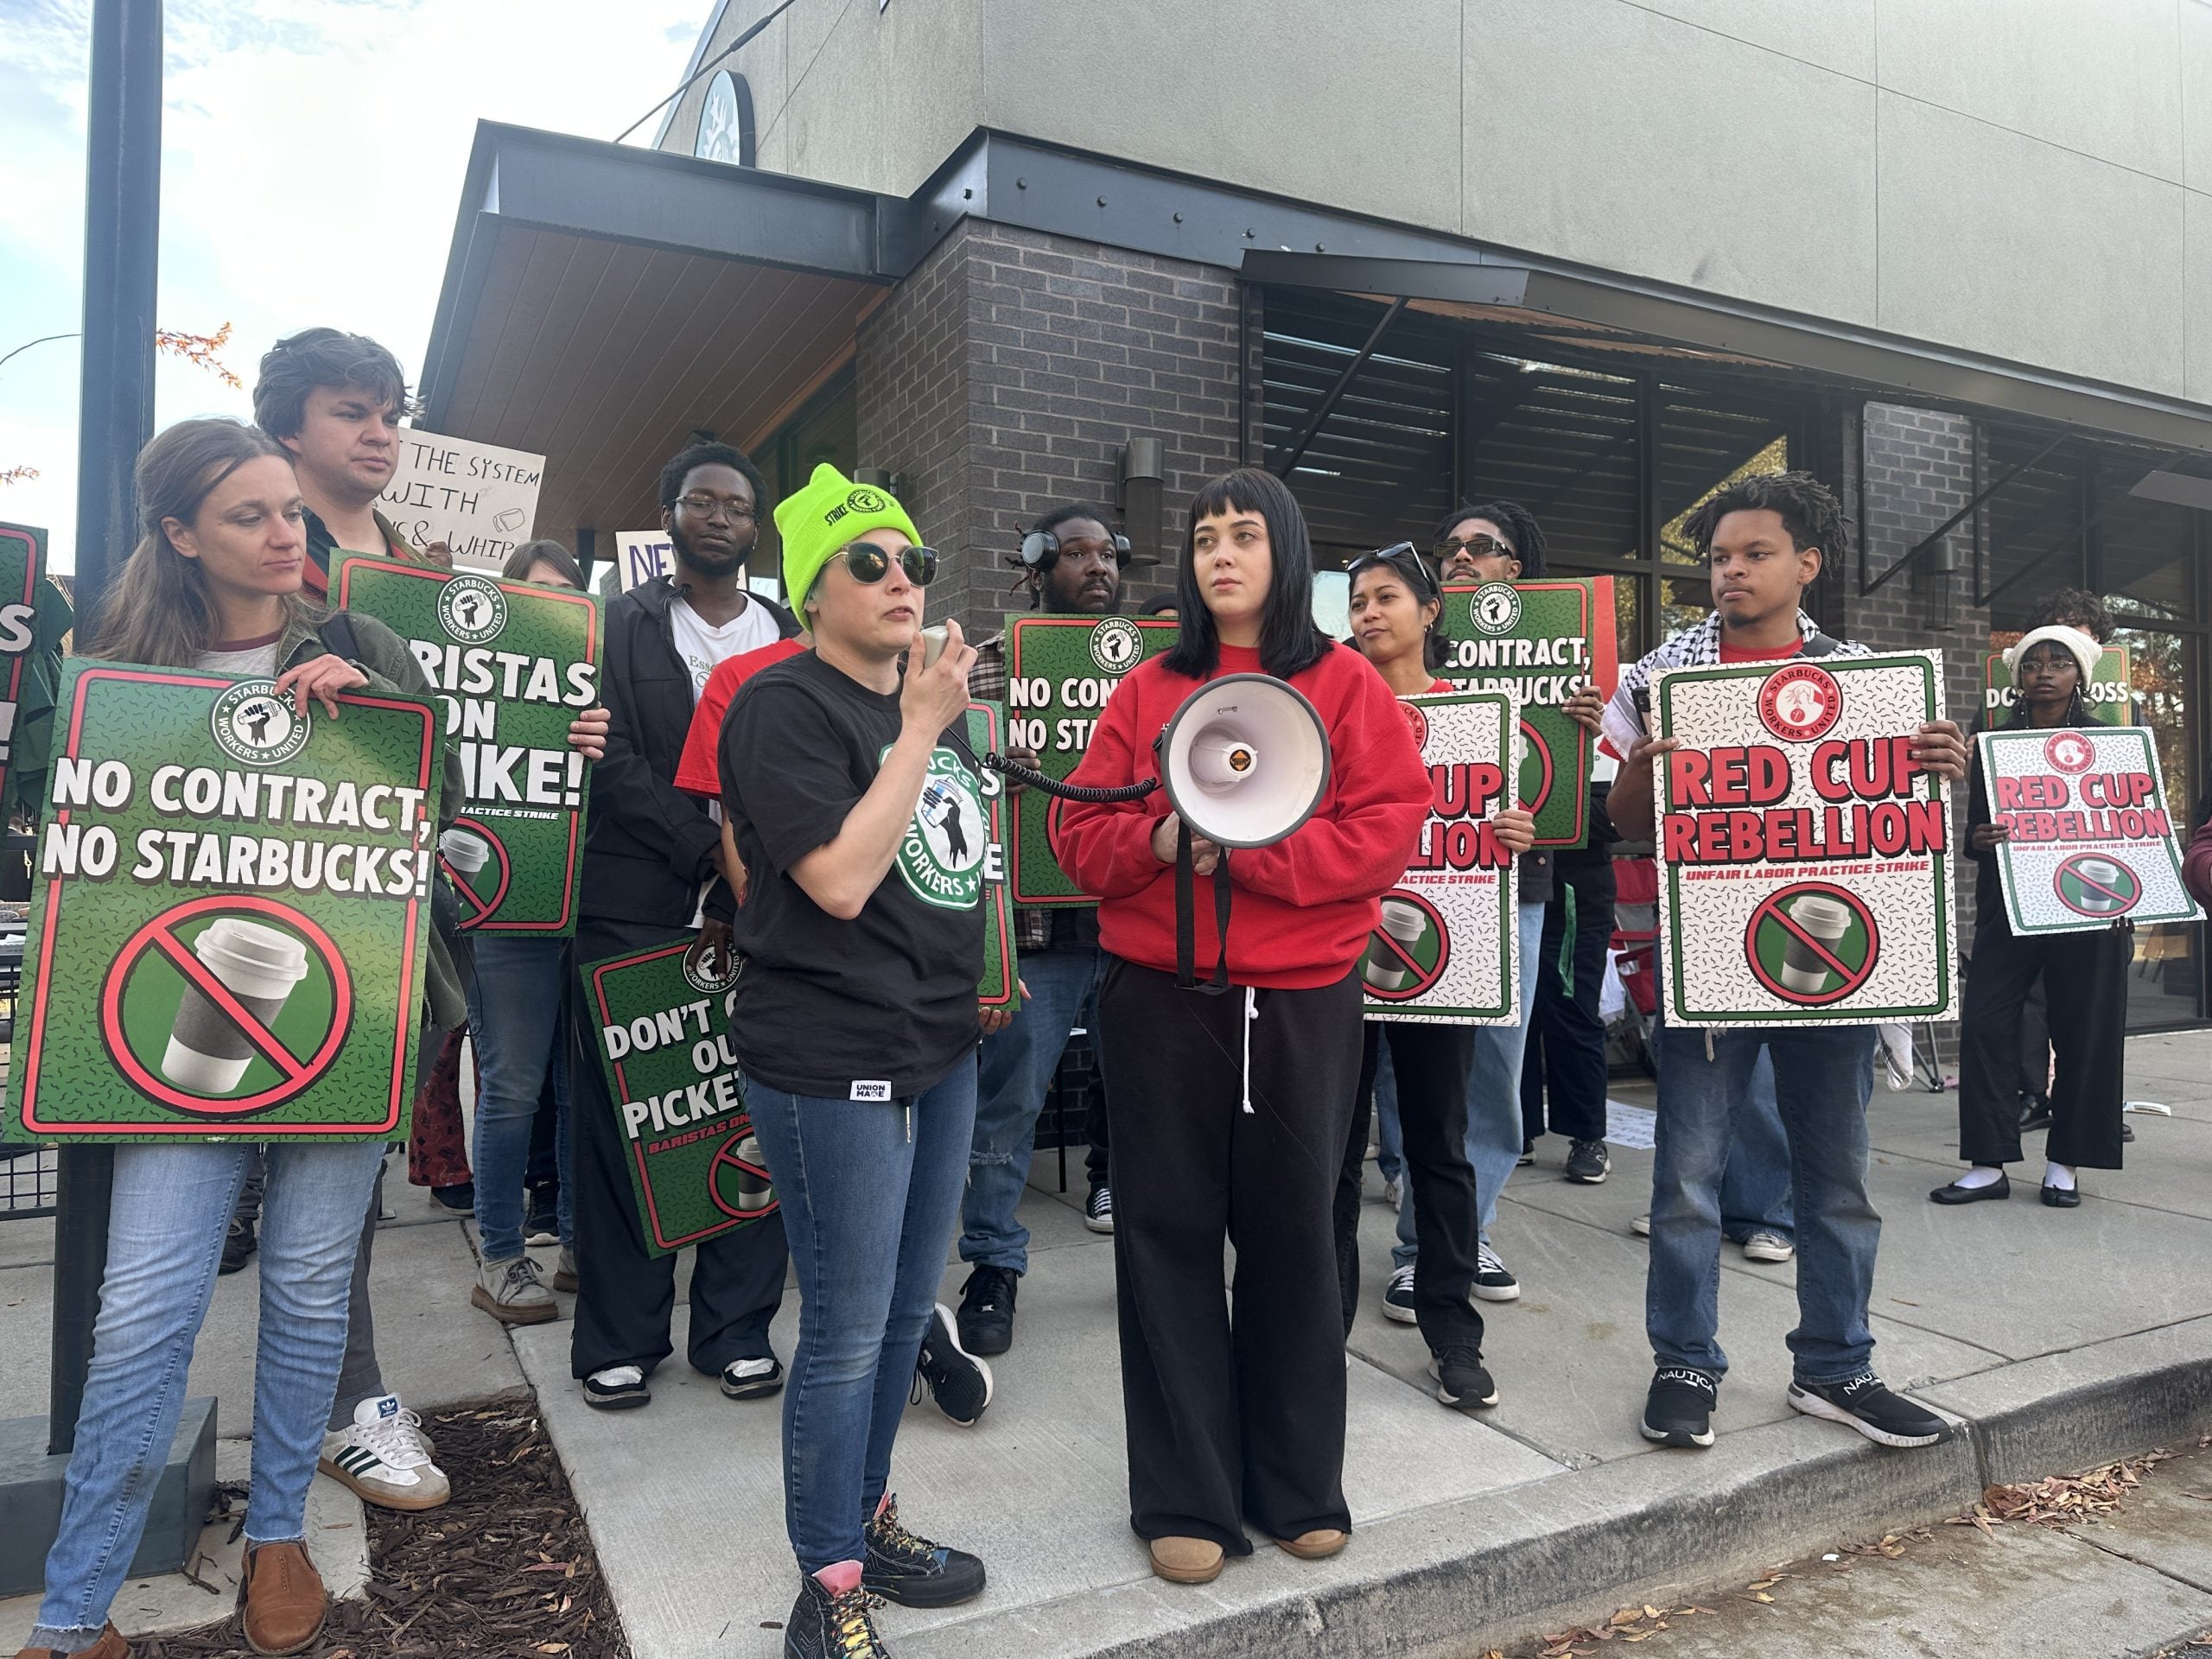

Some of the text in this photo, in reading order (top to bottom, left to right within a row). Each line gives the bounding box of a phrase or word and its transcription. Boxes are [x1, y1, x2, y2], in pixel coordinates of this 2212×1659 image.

[410, 442, 540, 486] THE SYSTEM
[380, 481, 479, 514] WITH
[824, 503, 849, 527] STRIKE
[449, 579, 499, 601] STARBUCKS
[1477, 585, 1515, 600] STARBUCKS
[442, 605, 470, 639] WORKERS
[480, 613, 502, 638] UNITED
[1098, 620, 1136, 636] STARBUCKS
[1473, 608, 1496, 632] WORKERS
[1502, 607, 1518, 628] UNITED
[410, 639, 596, 706] RISTAS
[1093, 645, 1116, 670] WORKERS
[1123, 645, 1140, 667] UNITED
[1009, 677, 1051, 708] NO
[1770, 670, 1831, 692] STARBUCKS
[1765, 698, 1802, 737] WORKERS
[1811, 696, 1836, 734] UNITED
[218, 716, 258, 760] WORKERS
[271, 724, 304, 759] UNITED
[1008, 719, 1047, 750] NO
[461, 741, 585, 806] IKE!
[1670, 736, 1931, 809] RED CUP
[52, 758, 431, 841] NO CONTRACT,
[1428, 763, 1503, 818] UP
[1996, 772, 2157, 810] RED CUP
[513, 810, 559, 820] STRIKE
[1995, 809, 2171, 842] REBELLION
[1663, 801, 1947, 864] REBELLION
[42, 823, 430, 897] NO STARBUCKS!
[1686, 861, 1929, 880] UNFAIR LABOR PRACTICE STRIKE
[1448, 875, 1496, 884] STRIKE
[726, 956, 740, 982] UNITED
[603, 998, 711, 1060] DON'T
[622, 1071, 739, 1140] PICKE
[648, 1121, 728, 1154] BARISTAS
[1658, 1370, 1714, 1396] NAUTICA
